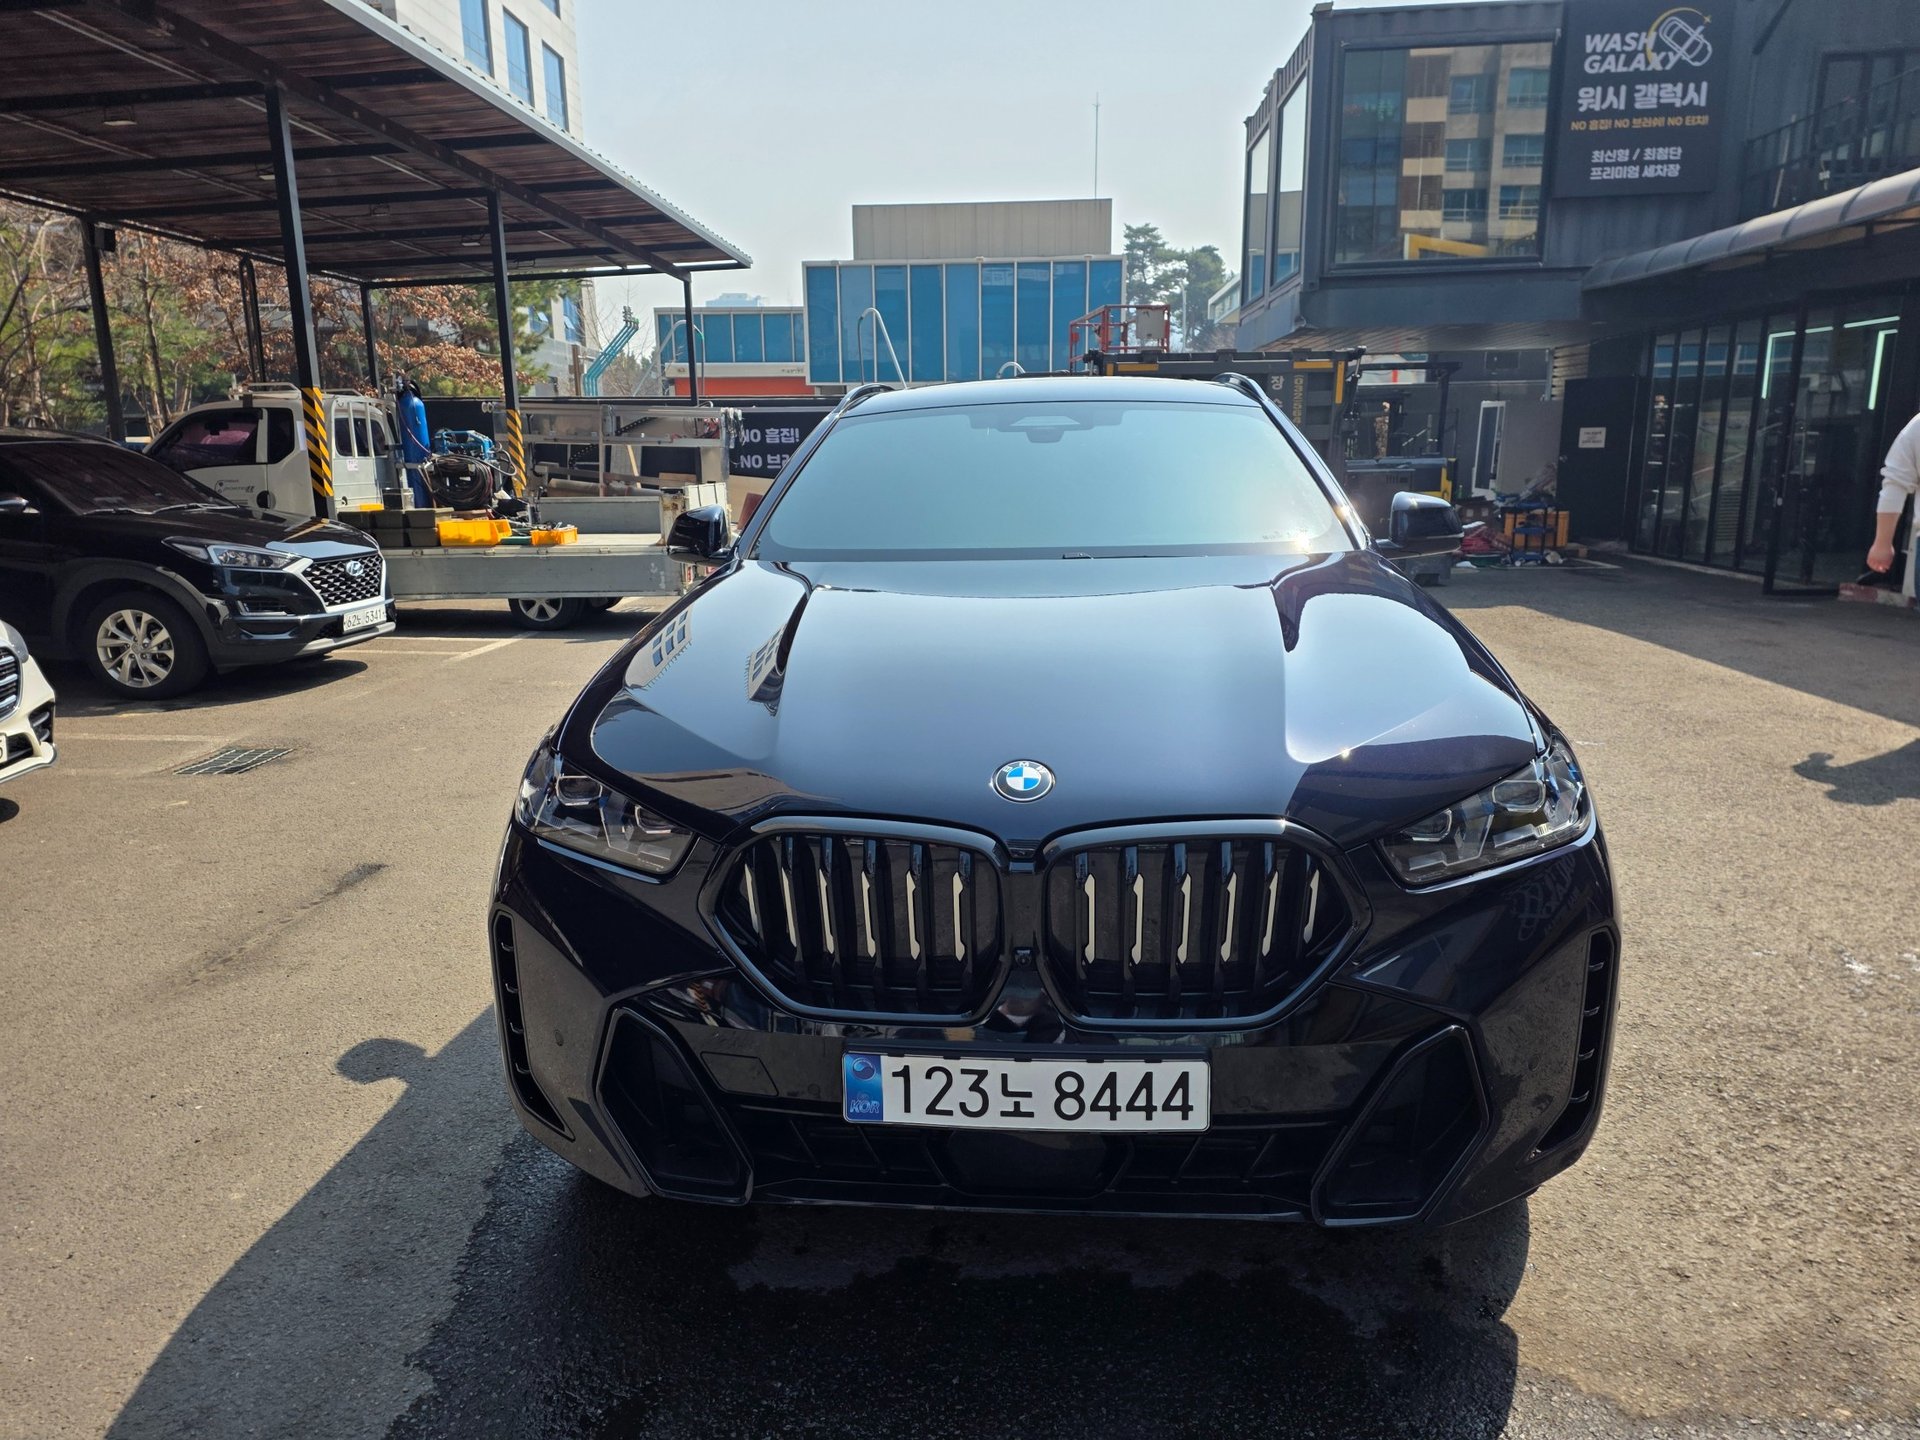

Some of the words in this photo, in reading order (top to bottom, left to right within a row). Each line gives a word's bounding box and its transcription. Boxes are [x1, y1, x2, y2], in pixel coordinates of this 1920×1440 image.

[1585, 31, 1657, 53] WASH
[1584, 51, 1679, 74] GALAXY
[1577, 84, 1627, 112] 워시
[1634, 81, 1708, 109] 갤럭시
[1571, 121, 1587, 130] NO
[1614, 118, 1630, 129] NO
[1667, 116, 1683, 127] NO
[1591, 148, 1630, 163] 최신형
[1643, 146, 1682, 160] 최첨단
[1590, 165, 1640, 180] 프리미엄
[1642, 163, 1681, 177] 세차장
[765, 427, 800, 444] 흠집!
[740, 454, 763, 469] NO
[365, 609, 382, 624] 5341
[891, 1064, 1035, 1118] 123노
[1053, 1070, 1195, 1122] 8444
[850, 1099, 881, 1114] KOR
